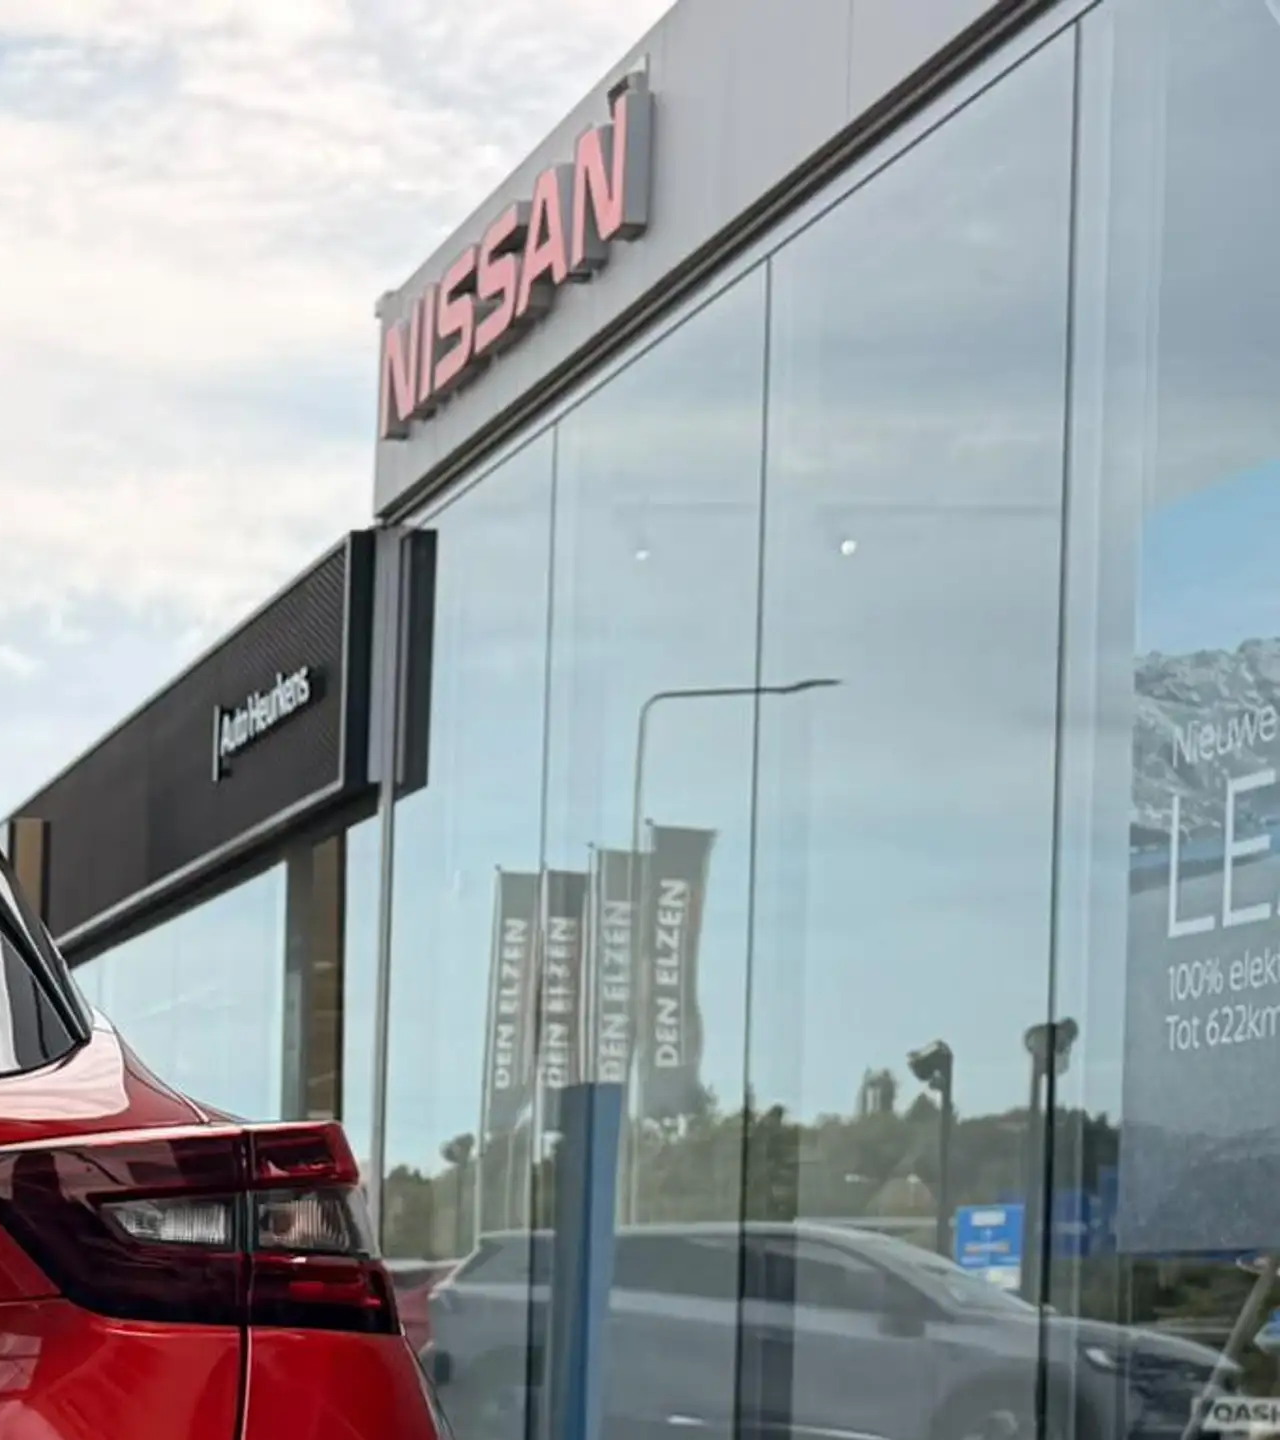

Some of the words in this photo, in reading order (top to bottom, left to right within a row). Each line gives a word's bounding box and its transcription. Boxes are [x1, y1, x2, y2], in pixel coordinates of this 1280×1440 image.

[380, 94, 628, 439] NISSAN
[1172, 704, 1278, 768] Nieuwe
[1168, 768, 1280, 938] LE
[655, 878, 689, 986] ELZEN
[1168, 956, 1224, 1004] 100%
[655, 998, 679, 1068] DEN
[1165, 1014, 1200, 1051] Tot
